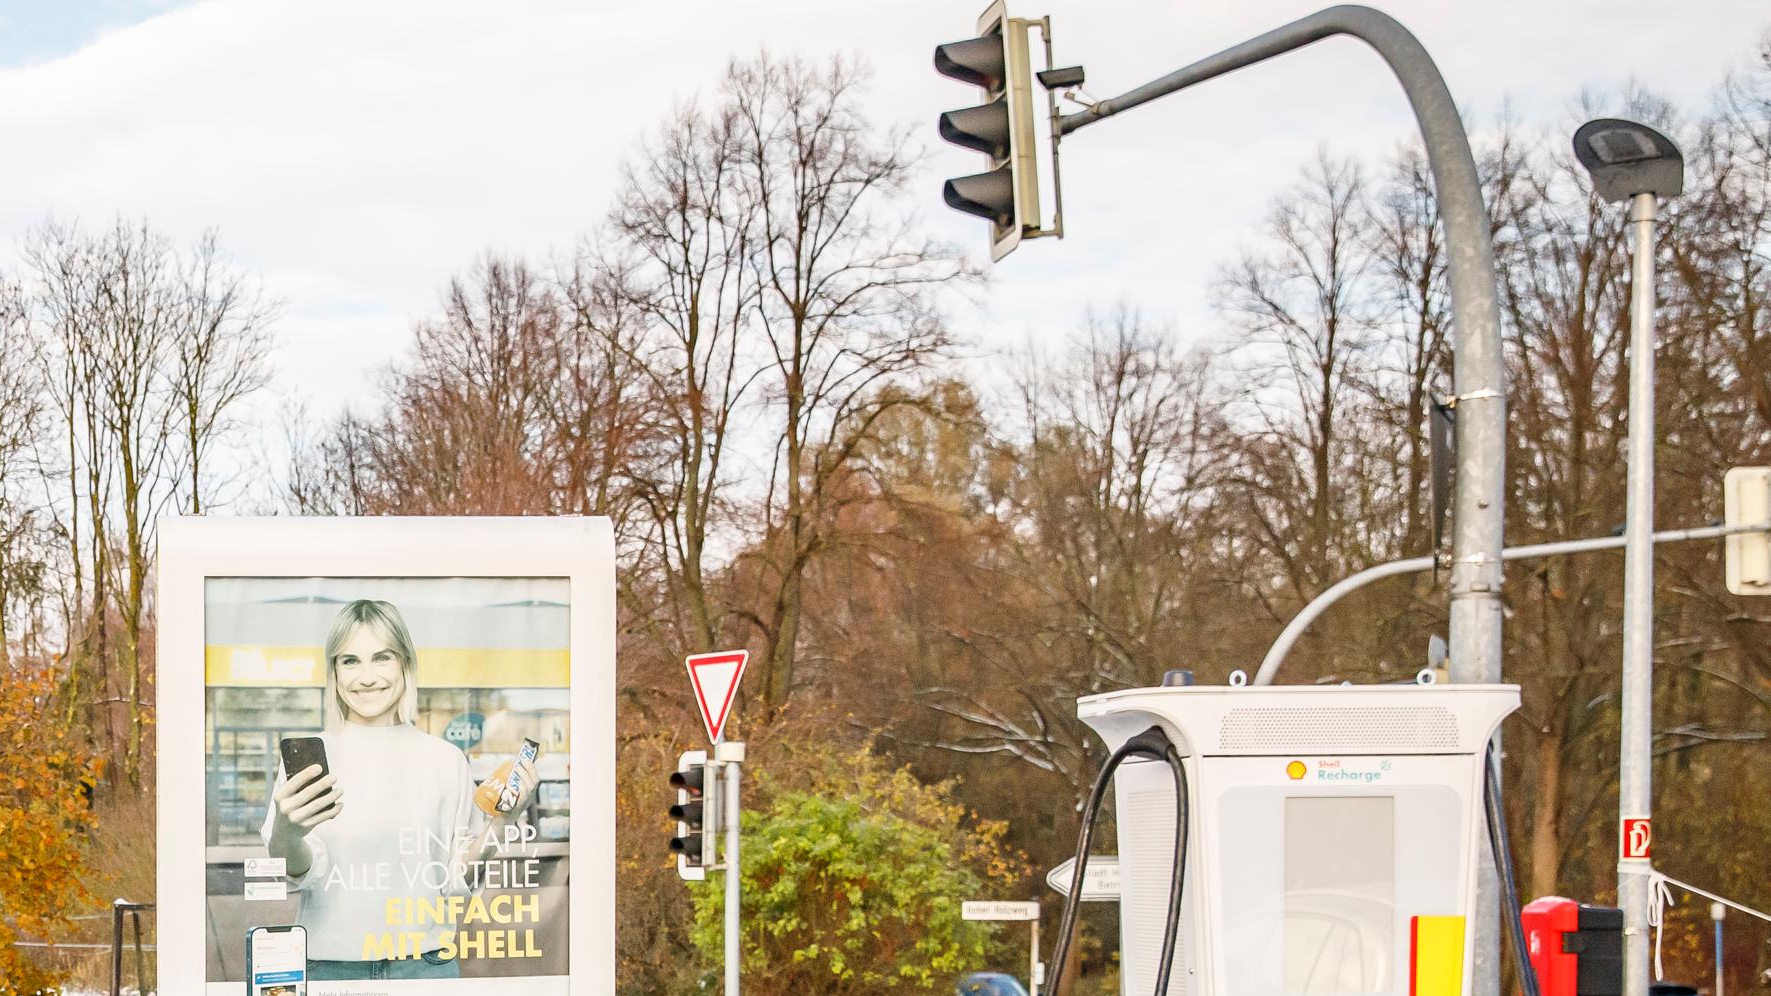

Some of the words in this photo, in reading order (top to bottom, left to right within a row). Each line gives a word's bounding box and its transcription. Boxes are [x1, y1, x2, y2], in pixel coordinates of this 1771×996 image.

[1317, 769, 1381, 782] Recharge
[398, 826, 471, 855] EINE
[479, 824, 539, 859] APP,
[324, 862, 390, 891] ALLE
[400, 859, 540, 892] VORTEILE
[385, 894, 540, 925] EINFACH
[361, 931, 425, 961] MIT
[437, 929, 543, 960] SHELL
